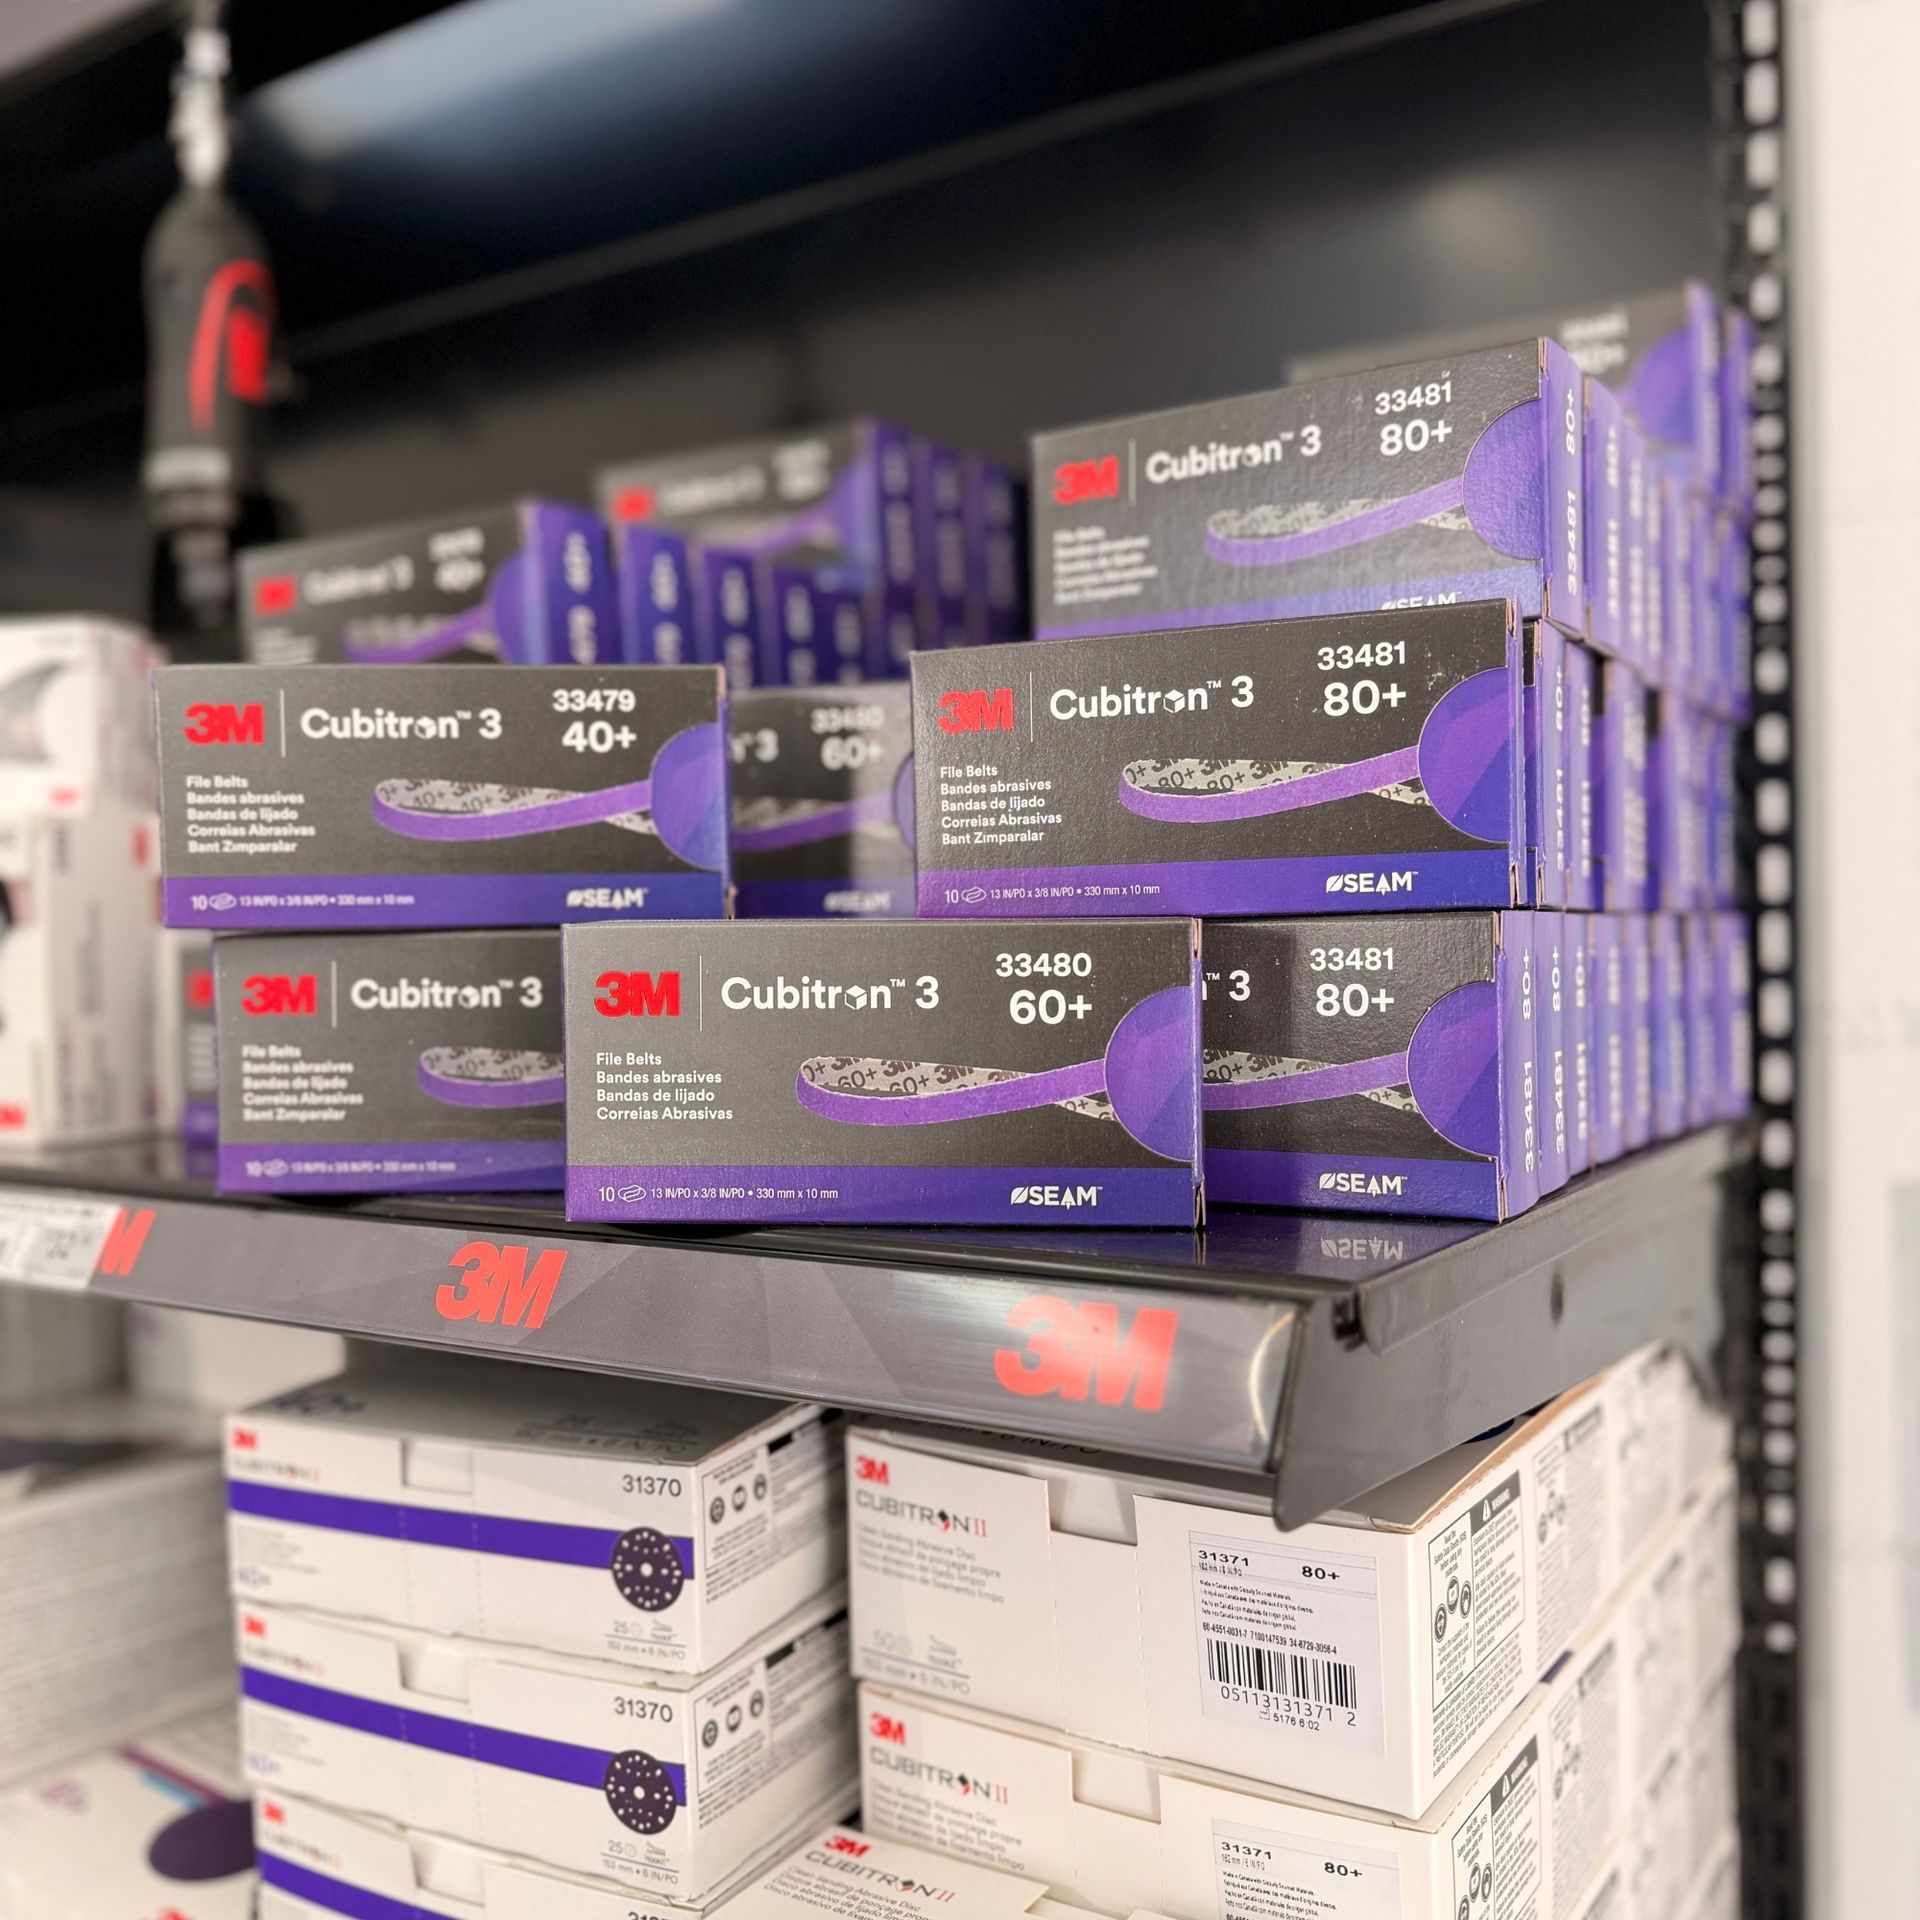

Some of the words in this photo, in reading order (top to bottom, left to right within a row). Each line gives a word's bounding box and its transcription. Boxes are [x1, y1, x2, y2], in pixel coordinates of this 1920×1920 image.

[1375, 380, 1452, 415] 33481
[1565, 389, 1575, 455] 80+
[1380, 419, 1452, 456] 80+
[1053, 456, 1119, 504] 3M
[1300, 424, 1321, 457] 3
[1567, 490, 1577, 594] 33481
[1317, 641, 1406, 670] 33481
[552, 689, 636, 712] 33479
[937, 688, 1014, 734] 3M
[1231, 676, 1254, 708] 3
[1323, 680, 1407, 717] 80+
[184, 703, 265, 745] 3M
[478, 708, 503, 739] 3
[562, 721, 637, 753] 40+
[821, 736, 881, 771] 60+
[186, 775, 210, 788] File
[214, 775, 248, 788] Belts
[940, 766, 963, 779] File
[966, 764, 998, 778] Belts
[186, 792, 236, 804] Bandes
[239, 792, 305, 804] abrasives
[940, 782, 987, 796] Bandes
[989, 779, 1052, 794] abrasives
[187, 808, 236, 820] Bandas
[240, 808, 256, 820] de
[260, 808, 298, 823] lijado
[941, 798, 987, 812] Bandas
[990, 798, 1006, 811] de
[1010, 796, 1045, 813] lijado
[187, 824, 246, 837] Correias
[249, 824, 316, 837] Abrasivas
[941, 816, 995, 829] Correias
[998, 812, 1062, 827] Abrasivas
[188, 841, 220, 853] Bant
[942, 833, 971, 846] Bant
[191, 895, 207, 911] 10
[945, 889, 959, 904] 10
[990, 888, 1001, 899] 13
[1003, 887, 1025, 899] IN/PO
[1027, 889, 1033, 898] x
[1034, 887, 1049, 898] 3/8
[1050, 886, 1074, 898] IN/PO
[1084, 885, 1101, 897] 330
[1103, 888, 1120, 896] mm
[1130, 885, 1141, 896] 10
[1143, 886, 1160, 895] mm
[995, 953, 1092, 977] 33480
[1309, 947, 1394, 972] 33481
[1229, 970, 1250, 1001] 3
[1522, 949, 1531, 1020] 80+
[1552, 946, 1561, 1012] 80+
[241, 973, 317, 1016] 3M
[519, 977, 543, 1008] 3
[594, 970, 681, 1018] 3M
[915, 976, 939, 1009] 3
[1315, 983, 1395, 1017] 80+
[1009, 990, 1092, 1025] 60+
[596, 1053, 622, 1066] File
[626, 1053, 662, 1066] Belts
[596, 1071, 649, 1084] Bandes
[653, 1071, 722, 1084] abrasives
[838, 1067, 877, 1088] 60+
[596, 1089, 649, 1102] Bandas
[653, 1089, 670, 1102] de
[674, 1089, 715, 1104] lijado
[1554, 1050, 1564, 1154] 33481
[596, 1107, 659, 1120] Correias
[662, 1107, 733, 1120] Abrasivas
[1524, 1061, 1533, 1173] 33481
[599, 1186, 614, 1202] 10
[651, 1188, 662, 1200] 13
[665, 1188, 691, 1200] IN/PO
[693, 1190, 699, 1199] x
[701, 1188, 716, 1200] 3/8
[719, 1188, 745, 1200] IN/PO
[756, 1188, 775, 1200] 330
[777, 1190, 795, 1200] mm
[797, 1190, 803, 1199] x
[806, 1188, 818, 1200] 10
[820, 1190, 838, 1200] mm
[435, 1242, 567, 1328] 3M
[993, 1296, 1178, 1411] 3M
[857, 1456, 889, 1486] 3M
[622, 1474, 682, 1497] 31370
[1198, 1549, 1249, 1567] 31371
[1301, 1566, 1340, 1580] 80+
[1250, 1630, 1287, 1646] 7100147539
[614, 1697, 673, 1723] 31370
[1220, 1685, 1333, 1721] 05113131371
[1346, 1711, 1357, 1727] 2
[870, 1713, 905, 1745] 3M
[1273, 1712, 1296, 1726] 5176
[824, 1835, 870, 1857] 3M
[1221, 1841, 1272, 1859] 31371
[1324, 1862, 1362, 1877] 80+
[898, 1901, 920, 1913] Disc
